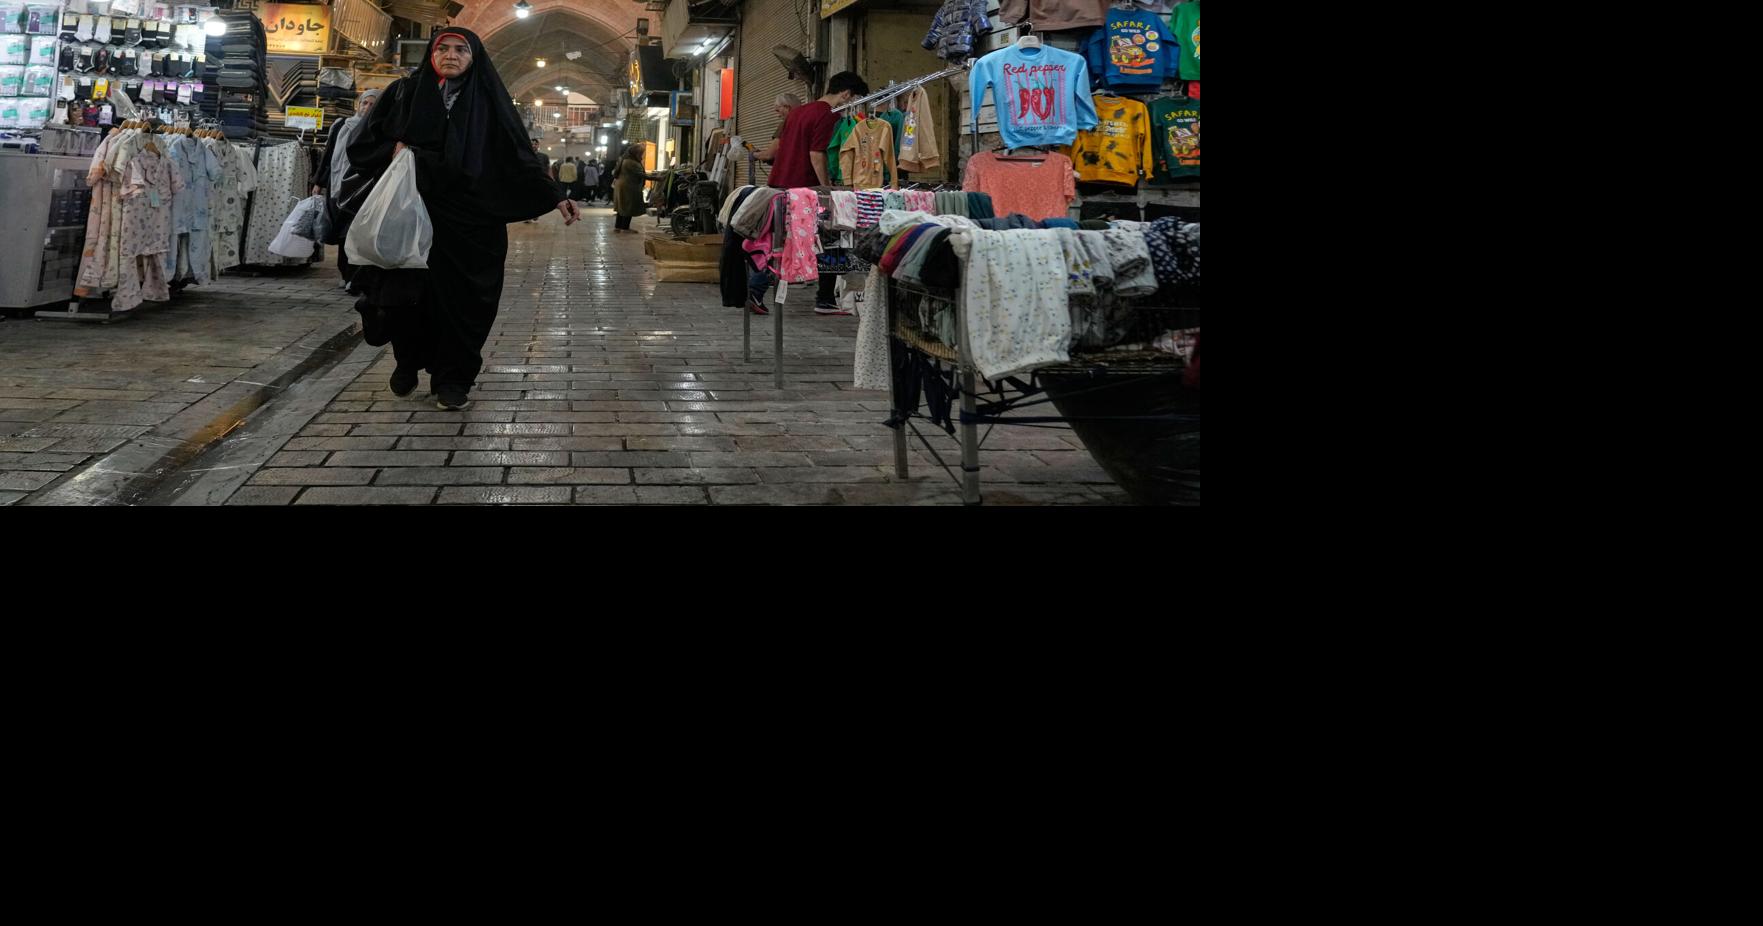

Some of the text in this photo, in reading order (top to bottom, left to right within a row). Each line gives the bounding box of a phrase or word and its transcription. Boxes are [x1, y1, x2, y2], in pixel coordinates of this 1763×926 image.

[265, 17, 325, 36] جاودان
[1110, 20, 1151, 31] SAFARI
[1004, 63, 1066, 76] Red pepper
